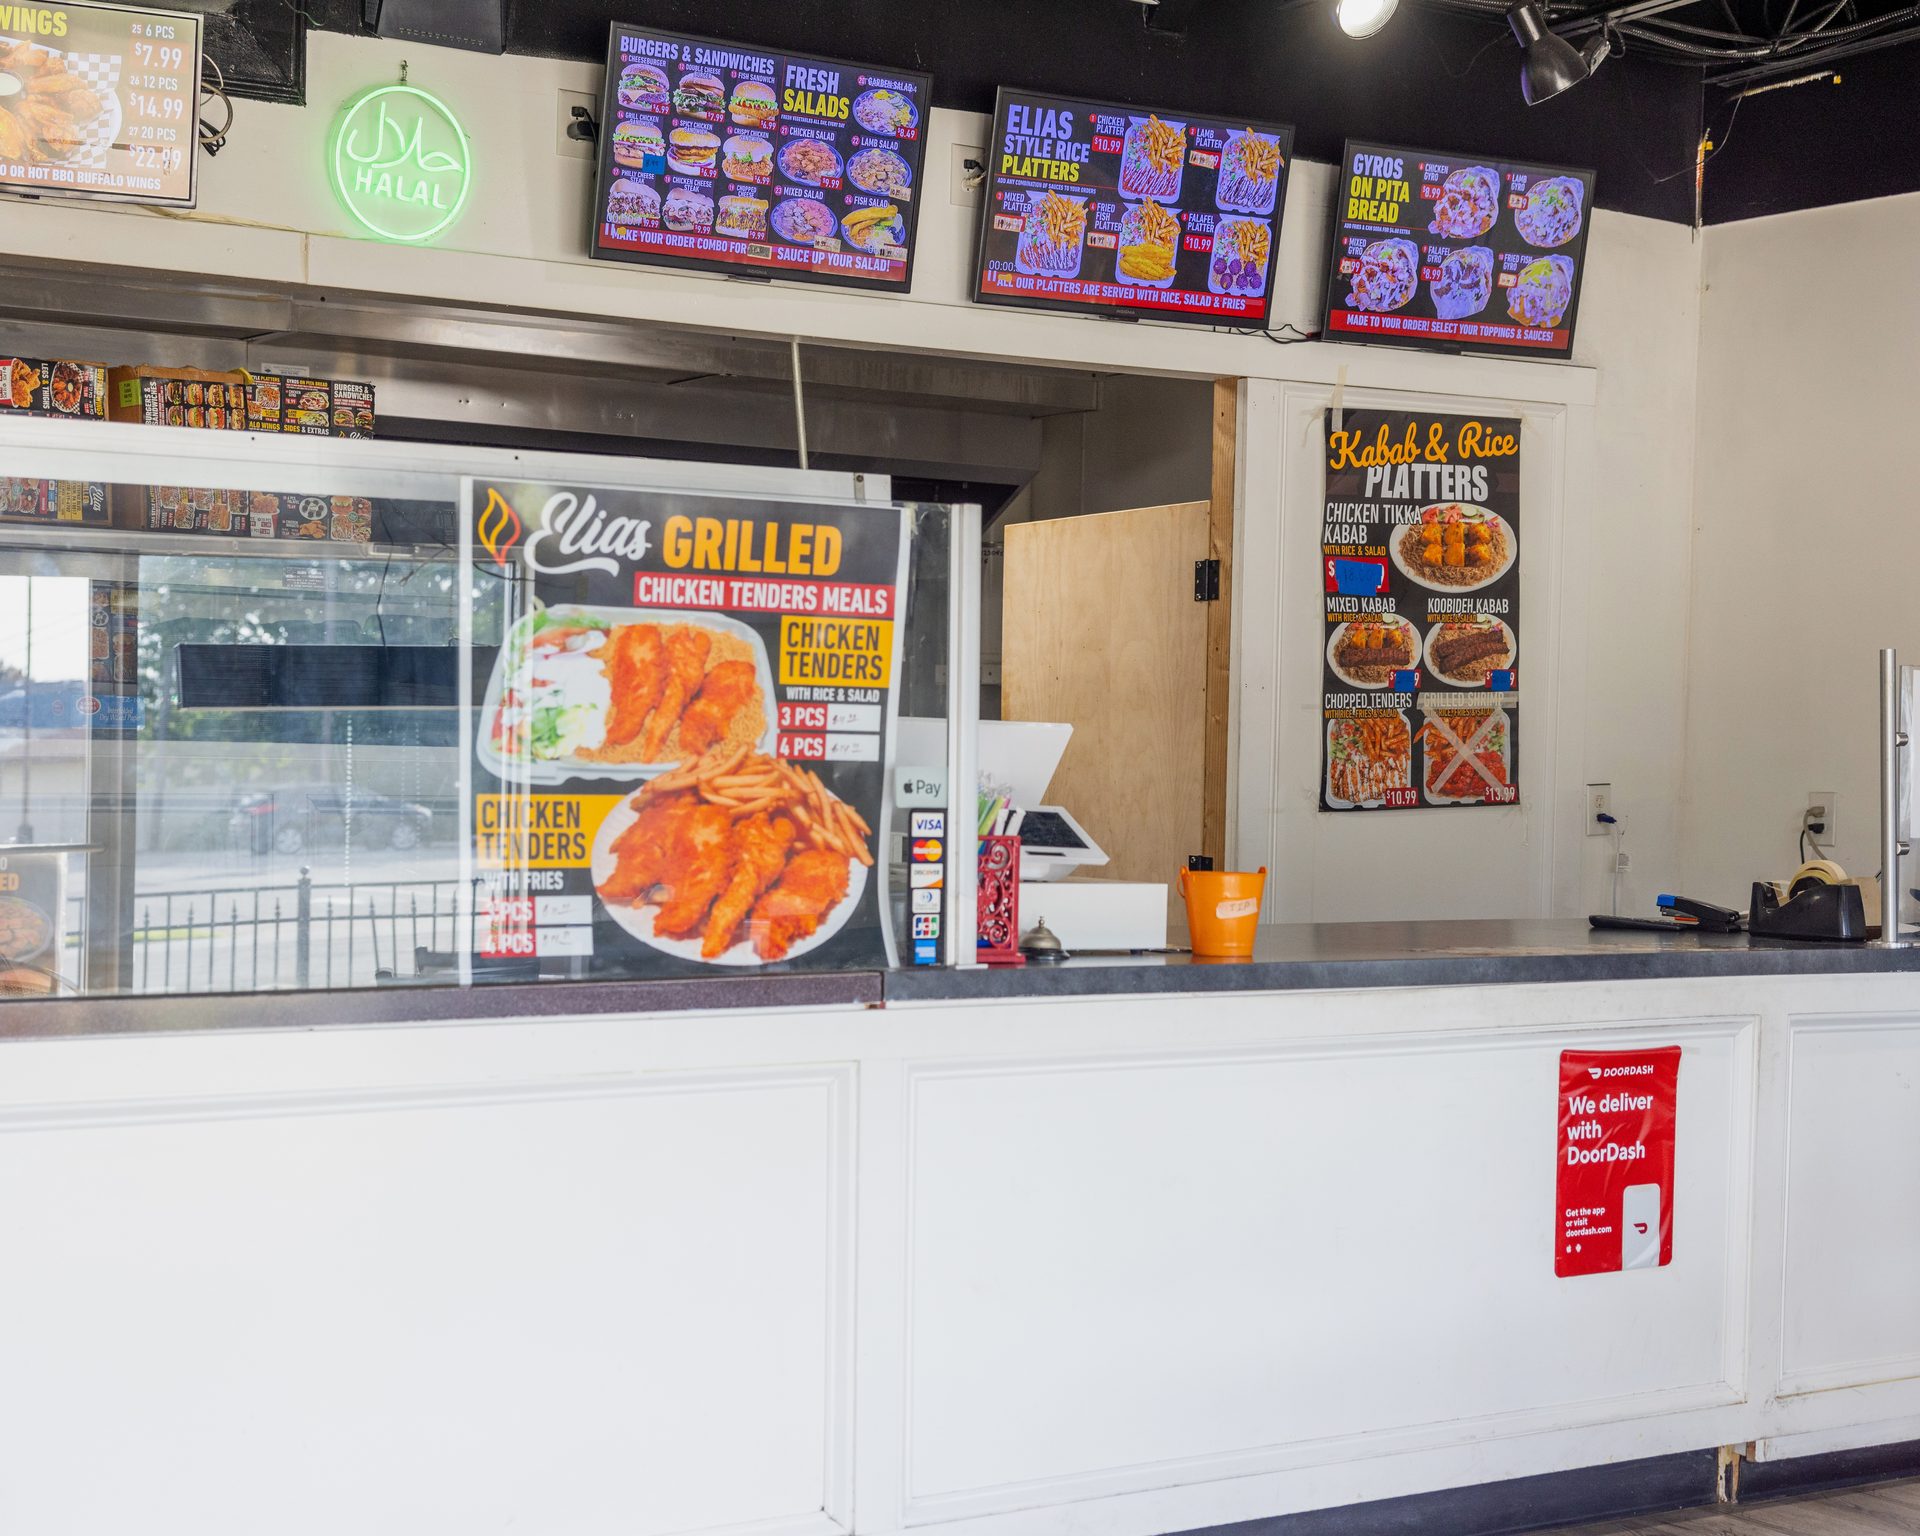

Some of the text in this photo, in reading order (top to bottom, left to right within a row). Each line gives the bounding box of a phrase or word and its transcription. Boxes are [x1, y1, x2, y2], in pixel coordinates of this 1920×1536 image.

[135, 42, 182, 69] $7.99
[620, 36, 774, 75] BURGERS & SANDWICHES
[628, 55, 666, 67] CHEESEBURGER
[786, 65, 839, 94] FRESH
[130, 93, 183, 119] $14.99
[783, 89, 849, 120] SALADS
[1007, 104, 1074, 140] ELIAS
[1097, 115, 1125, 126] CHICKEN
[790, 127, 835, 141] CHICKEN SALAD
[1096, 124, 1124, 136] PLATTER
[1197, 128, 1214, 138] LAMB
[1003, 134, 1090, 163] STYLE RICE
[1094, 137, 1121, 152] $10.99
[1196, 137, 1222, 149] PLATTER
[1002, 154, 1080, 182] PLATTERS
[1353, 153, 1403, 180] GYROS
[1425, 163, 1448, 174] CHICKEN
[10, 166, 161, 189] OR HOT BBQ BUFFALO WINGS
[822, 179, 840, 188] $9.99
[1424, 172, 1439, 181] GYRO
[355, 166, 448, 210] HALAL
[1350, 176, 1410, 203] ON PITA
[1423, 186, 1441, 198] $8.99
[1004, 192, 1025, 202] MIXED
[1003, 202, 1032, 212] PLATTER
[1097, 203, 1115, 213] FRIED
[1348, 197, 1399, 223] BREAD
[1096, 212, 1110, 221] FISH
[1188, 213, 1214, 224] FALAFEL
[1095, 220, 1122, 232] PLATTER
[1188, 222, 1214, 233] PLATTER
[640, 231, 663, 244] YOUR
[665, 234, 694, 249] ORDER
[697, 238, 727, 252] COMBO
[730, 241, 747, 254] FOR
[1186, 236, 1212, 250] $10.99
[777, 247, 809, 263] SAUCE
[812, 252, 826, 264] UP
[828, 255, 852, 268] YOUR
[855, 259, 890, 272] SALAD!
[1016, 277, 1034, 290] OUR
[1036, 279, 1080, 294] PLATTERS
[1082, 283, 1100, 296] ARE
[1102, 286, 1134, 299] SERVED
[1137, 288, 1159, 302] WITH
[1162, 291, 1182, 305] RICE,
[1184, 294, 1211, 308] SALAD
[1214, 297, 1220, 308] &
[1222, 298, 1246, 311] FRIES
[1347, 314, 1553, 342] MADE TO YOUR ORDER! SELECT YOUR TOPPINGS & SAUCES!
[334, 384, 364, 393] BURGERS
[334, 390, 373, 401] SANDWICHES
[262, 422, 280, 430] WINGS
[284, 424, 300, 432] SIDES
[308, 427, 330, 435] EXTRAS
[1329, 421, 1519, 470] Kabab & Rice
[1365, 463, 1489, 501] PLATTERS
[1326, 503, 1422, 525] CHICKEN TIKKA
[523, 491, 843, 578] Elias GRILLED
[1324, 523, 1367, 544] KABAB
[1323, 545, 1386, 556] WITH RICE & SALAD
[639, 575, 888, 615] CHICKEN TENDERS MEALS
[1327, 597, 1396, 613] MIXED KABAB
[1427, 598, 1509, 613] KOOBIDEH KABAB
[787, 622, 880, 651] CHICKEN
[786, 652, 883, 680] TENDERS
[786, 687, 880, 702] WITH RICE & SALAD
[1325, 693, 1412, 709] CHOPPED TENDERS
[781, 707, 791, 726] 3
[794, 708, 825, 727] PCS
[779, 737, 789, 756] 4
[793, 737, 823, 756] PCS
[916, 780, 942, 796] Pay
[1386, 790, 1417, 805] $10.99
[482, 801, 581, 829] CHICKEN
[916, 819, 942, 830] VISA
[481, 832, 586, 861] TENDERS
[1604, 1065, 1654, 1078] DOORDASH
[1568, 1092, 1653, 1116] We deliver
[1567, 1120, 1602, 1141] with
[1567, 1140, 1645, 1166] DoorDash
[1565, 1207, 1605, 1217] Get the app
[1574, 1218, 1588, 1227] visit
[1566, 1226, 1612, 1238] doordash.com
